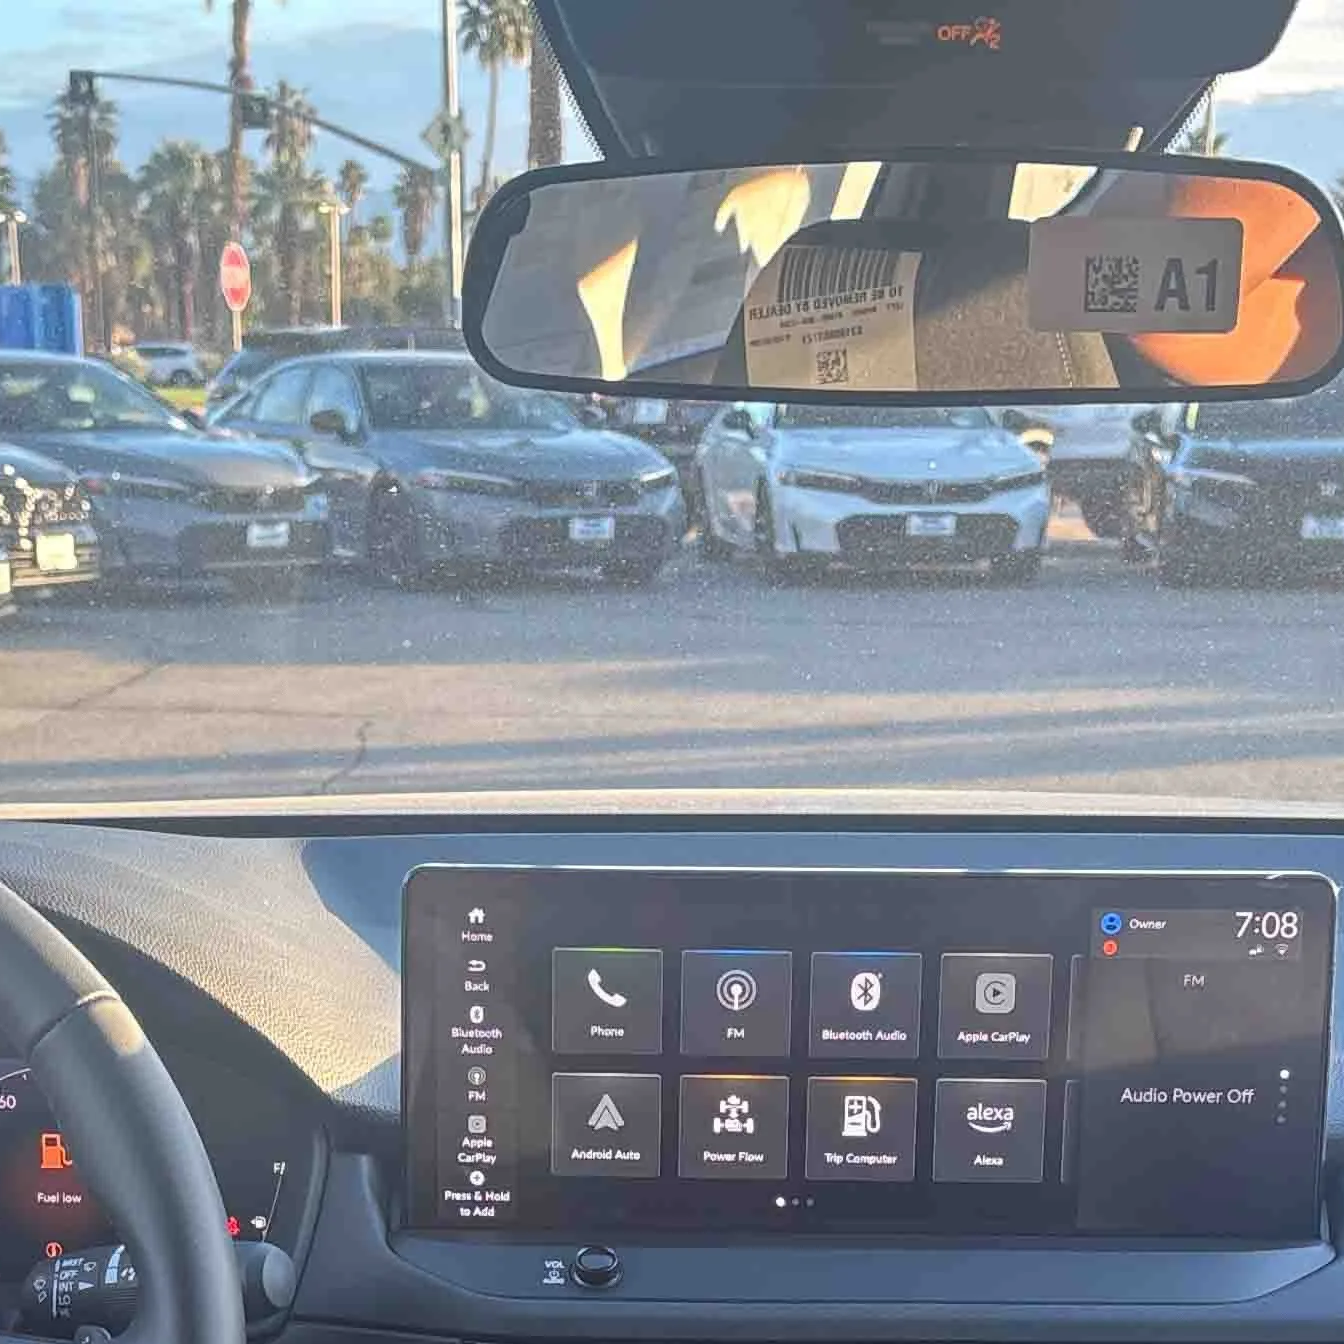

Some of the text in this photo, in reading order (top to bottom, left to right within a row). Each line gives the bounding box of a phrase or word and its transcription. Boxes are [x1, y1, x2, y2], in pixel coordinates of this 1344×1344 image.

[937, 25, 971, 41] OFF
[1154, 257, 1220, 312] A1
[1129, 918, 1167, 930] Owner
[1235, 911, 1298, 939] 7:08
[461, 931, 493, 942] Home
[464, 980, 490, 992] Back
[1183, 973, 1205, 987] FM
[451, 1027, 502, 1039] Bluetooth
[590, 1026, 624, 1037] Phone
[727, 1027, 745, 1038] FM
[822, 1029, 907, 1041] Bluetooth Audio
[957, 1031, 1030, 1044] Apple CarPlay
[461, 1044, 493, 1055] Audio
[468, 1090, 486, 1101] FM
[1120, 1087, 1255, 1104] Audio Power Off
[966, 1103, 1014, 1121] alexa
[462, 1137, 493, 1149] Apple
[457, 1152, 496, 1165] CarPlay
[571, 1149, 640, 1160] Android Auto
[703, 1151, 764, 1162] Power Flow
[824, 1153, 897, 1166] Trip Computer
[974, 1155, 1003, 1166] Alexa
[37, 1192, 82, 1204] Fuel low
[444, 1190, 510, 1201] Press & Hold
[460, 1206, 495, 1217] to Add
[545, 1260, 565, 1269] VOL
